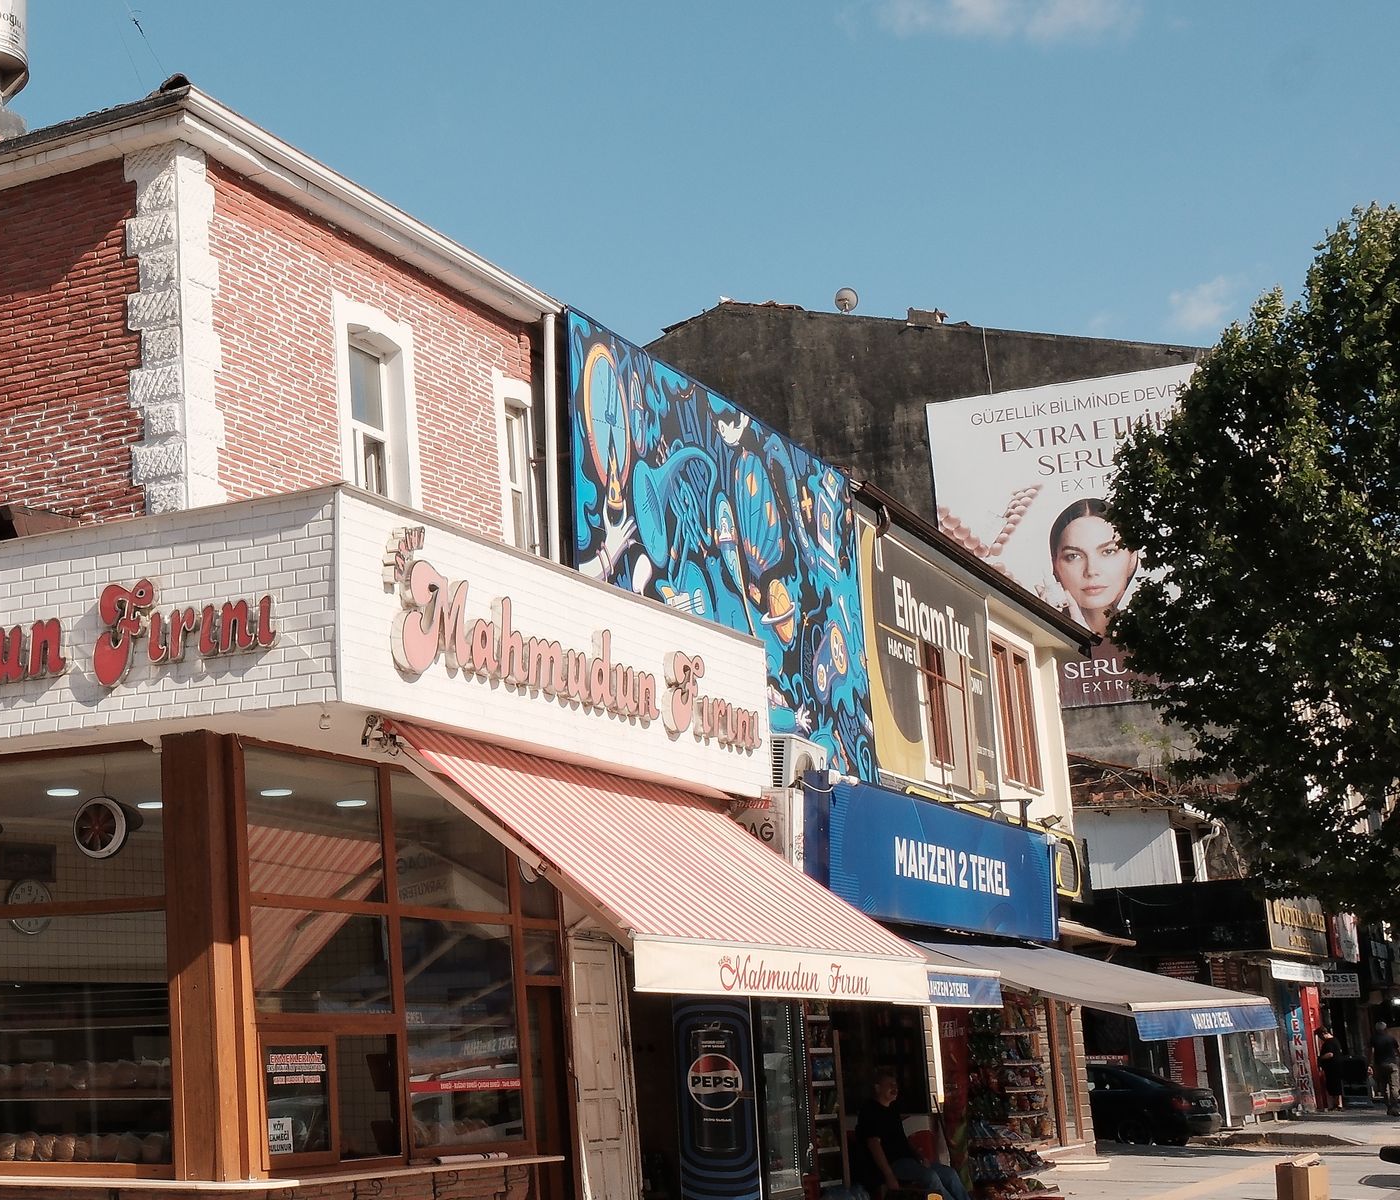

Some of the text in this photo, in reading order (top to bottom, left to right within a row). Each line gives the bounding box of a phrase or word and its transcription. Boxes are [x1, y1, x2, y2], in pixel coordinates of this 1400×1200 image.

[971, 401, 1047, 426] GÜZELLİK
[1050, 391, 1130, 415] BİLİMİNDE
[1000, 423, 1087, 453] EXTRA
[93, 578, 278, 688] Fırını
[893, 575, 973, 660] Elham Tur
[393, 560, 763, 750] Mahmudun Fırını
[887, 637, 903, 660] HAC
[903, 644, 914, 666] VE
[894, 835, 956, 887] MAHZEN
[958, 851, 969, 889] 2
[969, 853, 1011, 897] TEKEL
[720, 954, 870, 996] Mahmudun Fırını
[690, 1076, 739, 1089] PEPSI
[273, 1120, 284, 1132] KÖY
